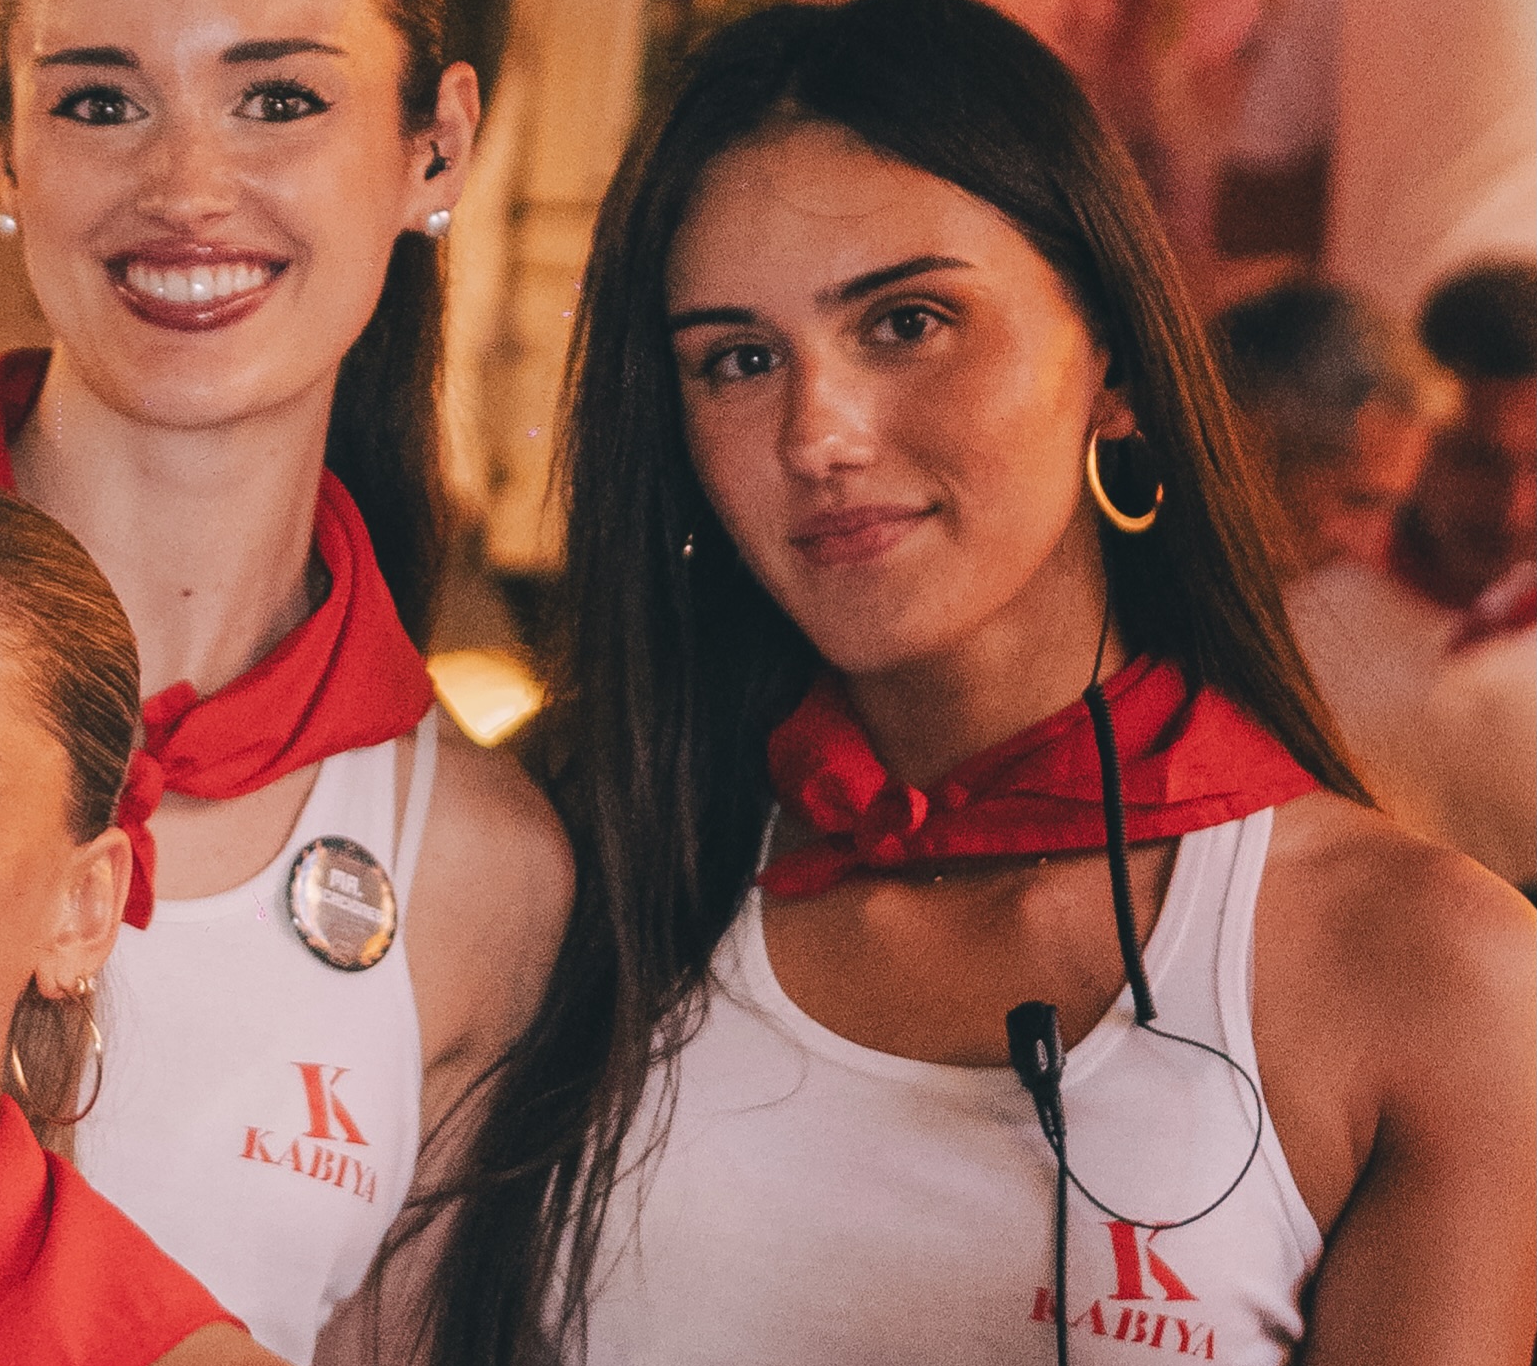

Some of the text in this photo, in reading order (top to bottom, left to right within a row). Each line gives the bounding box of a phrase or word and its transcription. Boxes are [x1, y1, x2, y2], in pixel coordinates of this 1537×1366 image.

[291, 1061, 370, 1146] K
[238, 1125, 377, 1204] KABIYA
[1100, 1220, 1199, 1301] K
